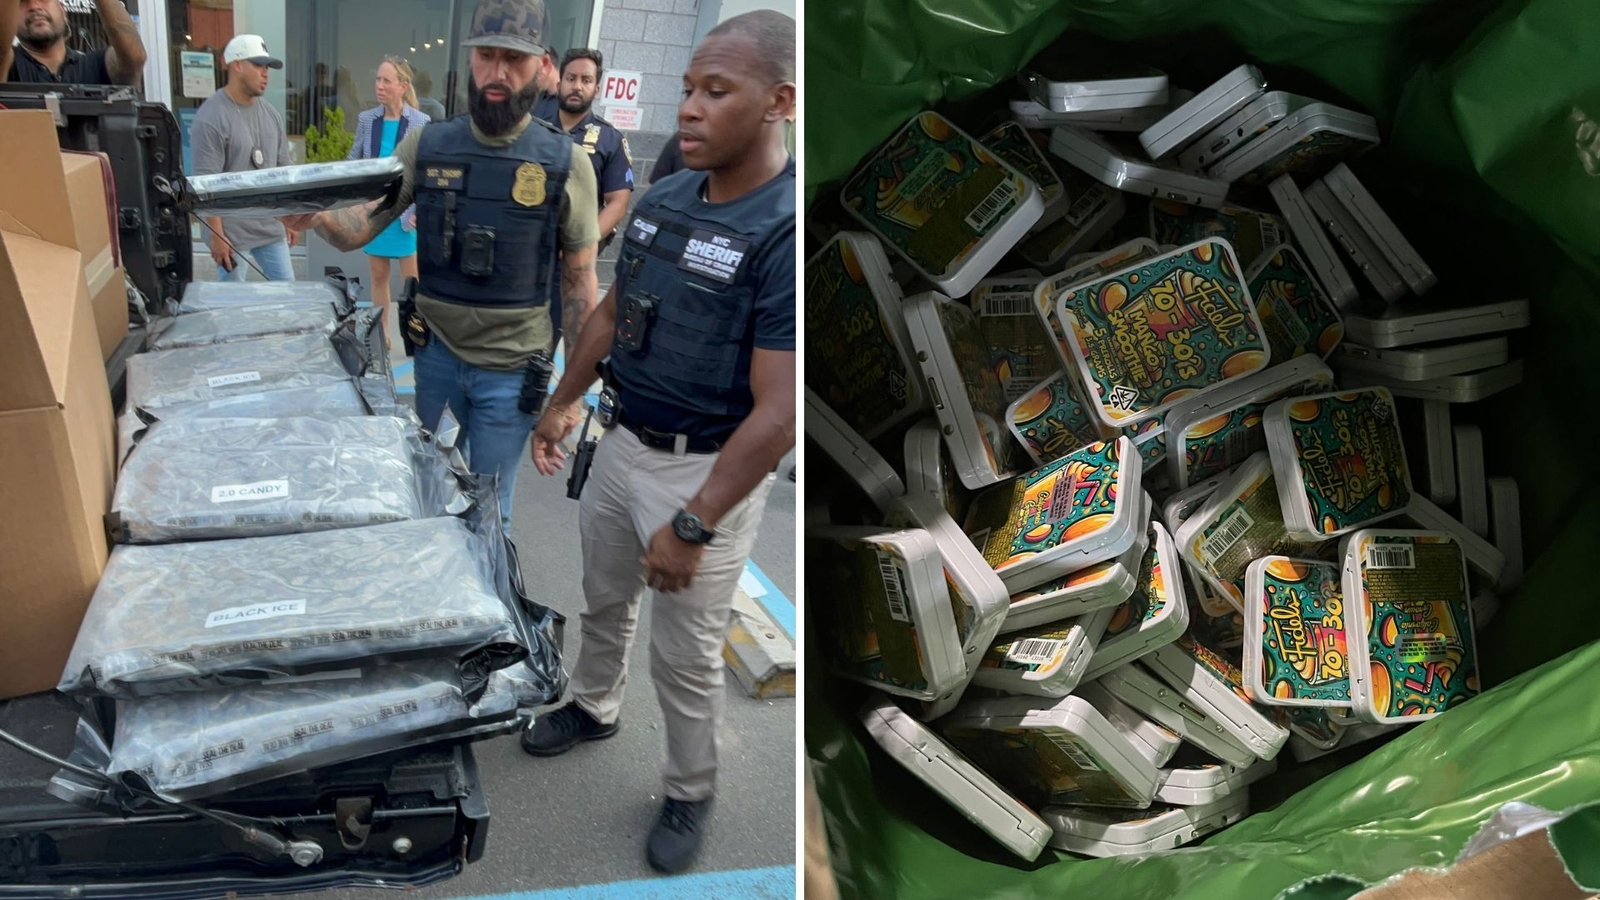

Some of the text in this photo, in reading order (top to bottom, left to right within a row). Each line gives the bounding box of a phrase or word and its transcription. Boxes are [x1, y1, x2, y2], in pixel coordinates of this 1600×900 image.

[604, 76, 637, 101] FDC
[685, 238, 744, 267] SHERIFF
[711, 235, 732, 247] NYC
[1127, 310, 1160, 368] MANGO
[1148, 279, 1178, 313] 70
[1166, 327, 1198, 381] 30's
[1085, 335, 1107, 379] 3.5 GRAMS
[1094, 329, 1118, 381] 5 PREROLLS
[1107, 309, 1148, 384] SMOOTHIE
[1109, 394, 1120, 409] CA
[1336, 408, 1356, 456] 30's
[1359, 427, 1377, 482] MANGO
[1367, 417, 1390, 486] SMOOTHIE
[217, 484, 283, 498] 2.0 CANDY
[1348, 474, 1366, 506] 70
[212, 602, 300, 622] BLACK ICE
[332, 631, 346, 642] SEAL
[1321, 649, 1344, 680] 70
[293, 726, 308, 738] SEAL
[308, 724, 319, 734] THE
[319, 719, 334, 731] DEAL
[202, 739, 245, 761] SEAL THE DEAL
